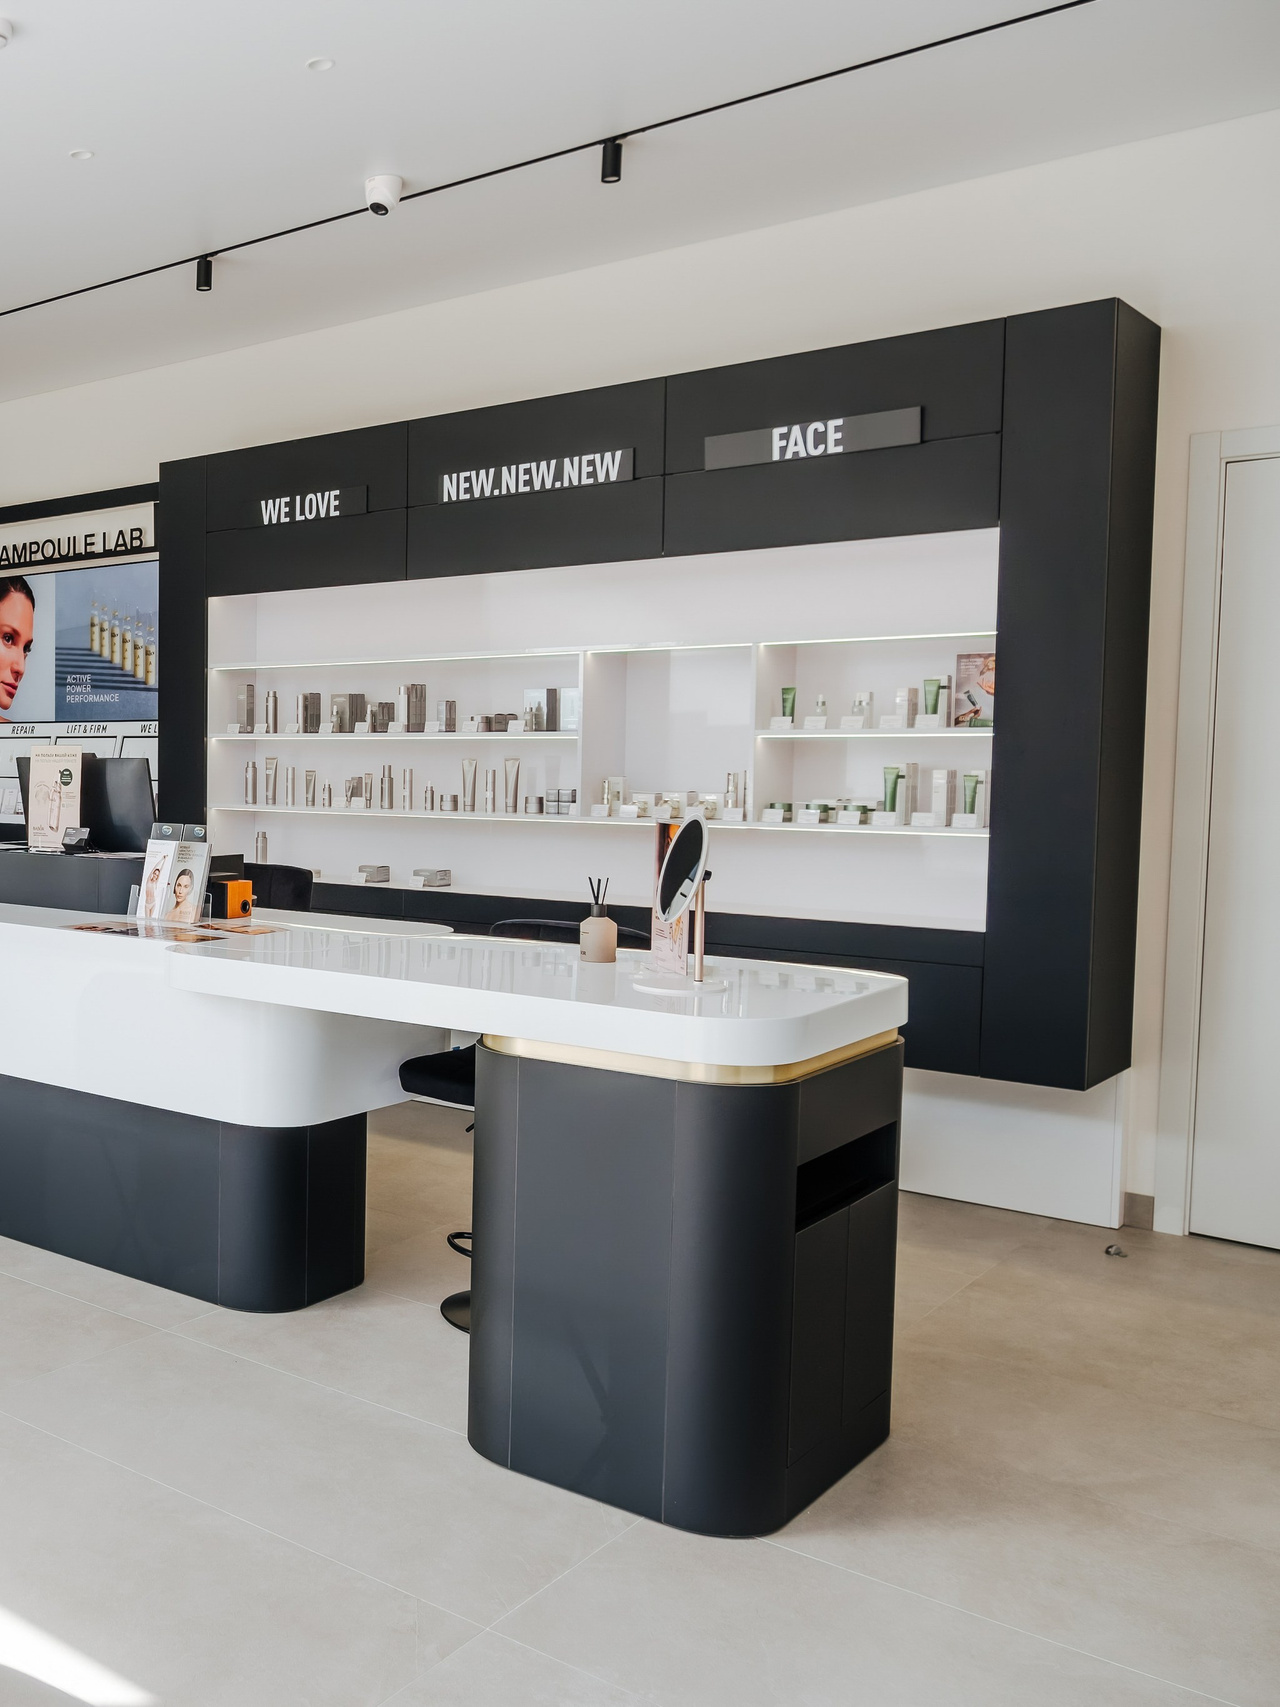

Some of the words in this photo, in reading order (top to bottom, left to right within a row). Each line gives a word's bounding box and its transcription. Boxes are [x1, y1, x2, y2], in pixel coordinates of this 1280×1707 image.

[771, 418, 844, 461] FACE
[443, 450, 622, 502] NEW.NEW.NEW
[260, 497, 290, 525] WE
[295, 489, 340, 521] LOVE
[102, 527, 144, 553] LAB
[66, 674, 91, 683] ACTIVE
[66, 684, 91, 693] POWER
[66, 693, 119, 703] PERFORMANCE
[11, 725, 36, 735] REPAIR
[66, 724, 82, 734] LIFT
[82, 724, 88, 734] &
[89, 724, 108, 733] FIRM
[140, 723, 152, 734] WE
